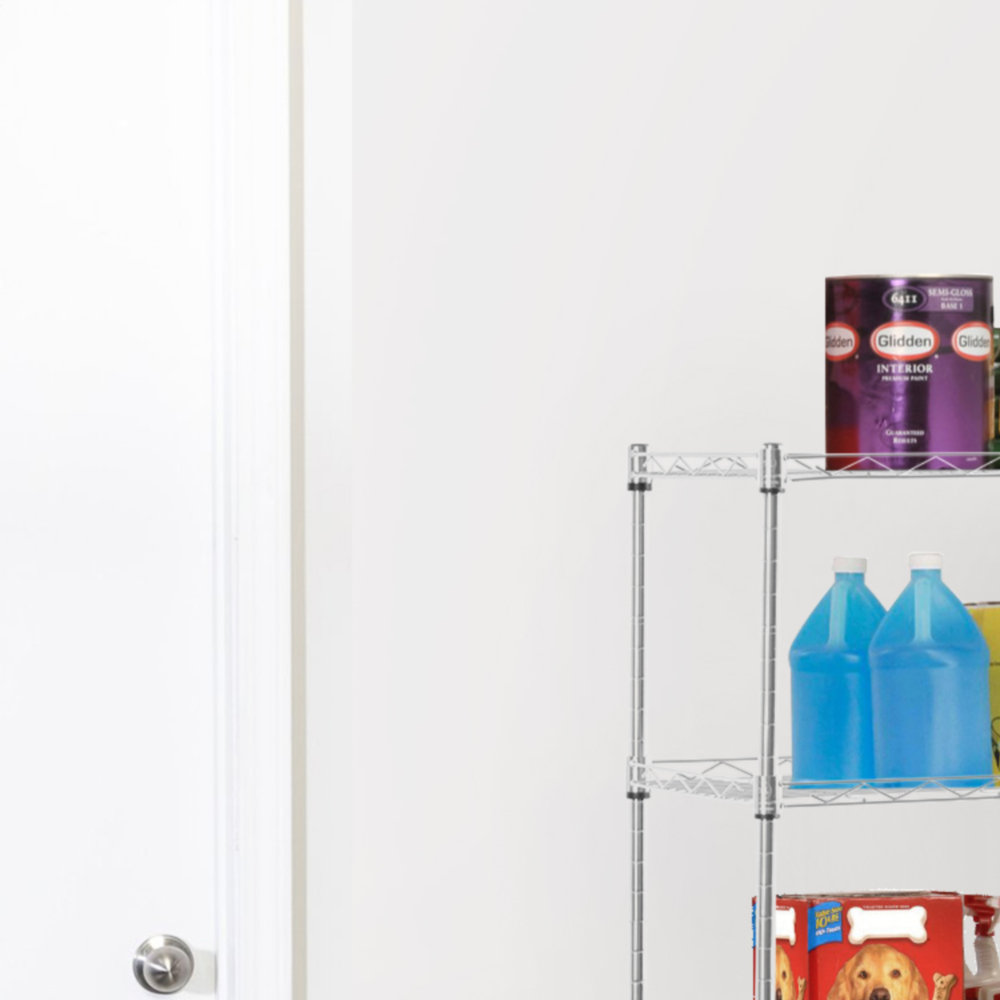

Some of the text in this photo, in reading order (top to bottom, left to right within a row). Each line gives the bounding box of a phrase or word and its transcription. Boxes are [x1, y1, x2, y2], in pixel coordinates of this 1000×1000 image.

[928, 288, 974, 297] SEMI-GLOSS
[890, 292, 918, 306] 6411
[877, 334, 933, 348] Glidden
[876, 363, 934, 374] INTERIOR
